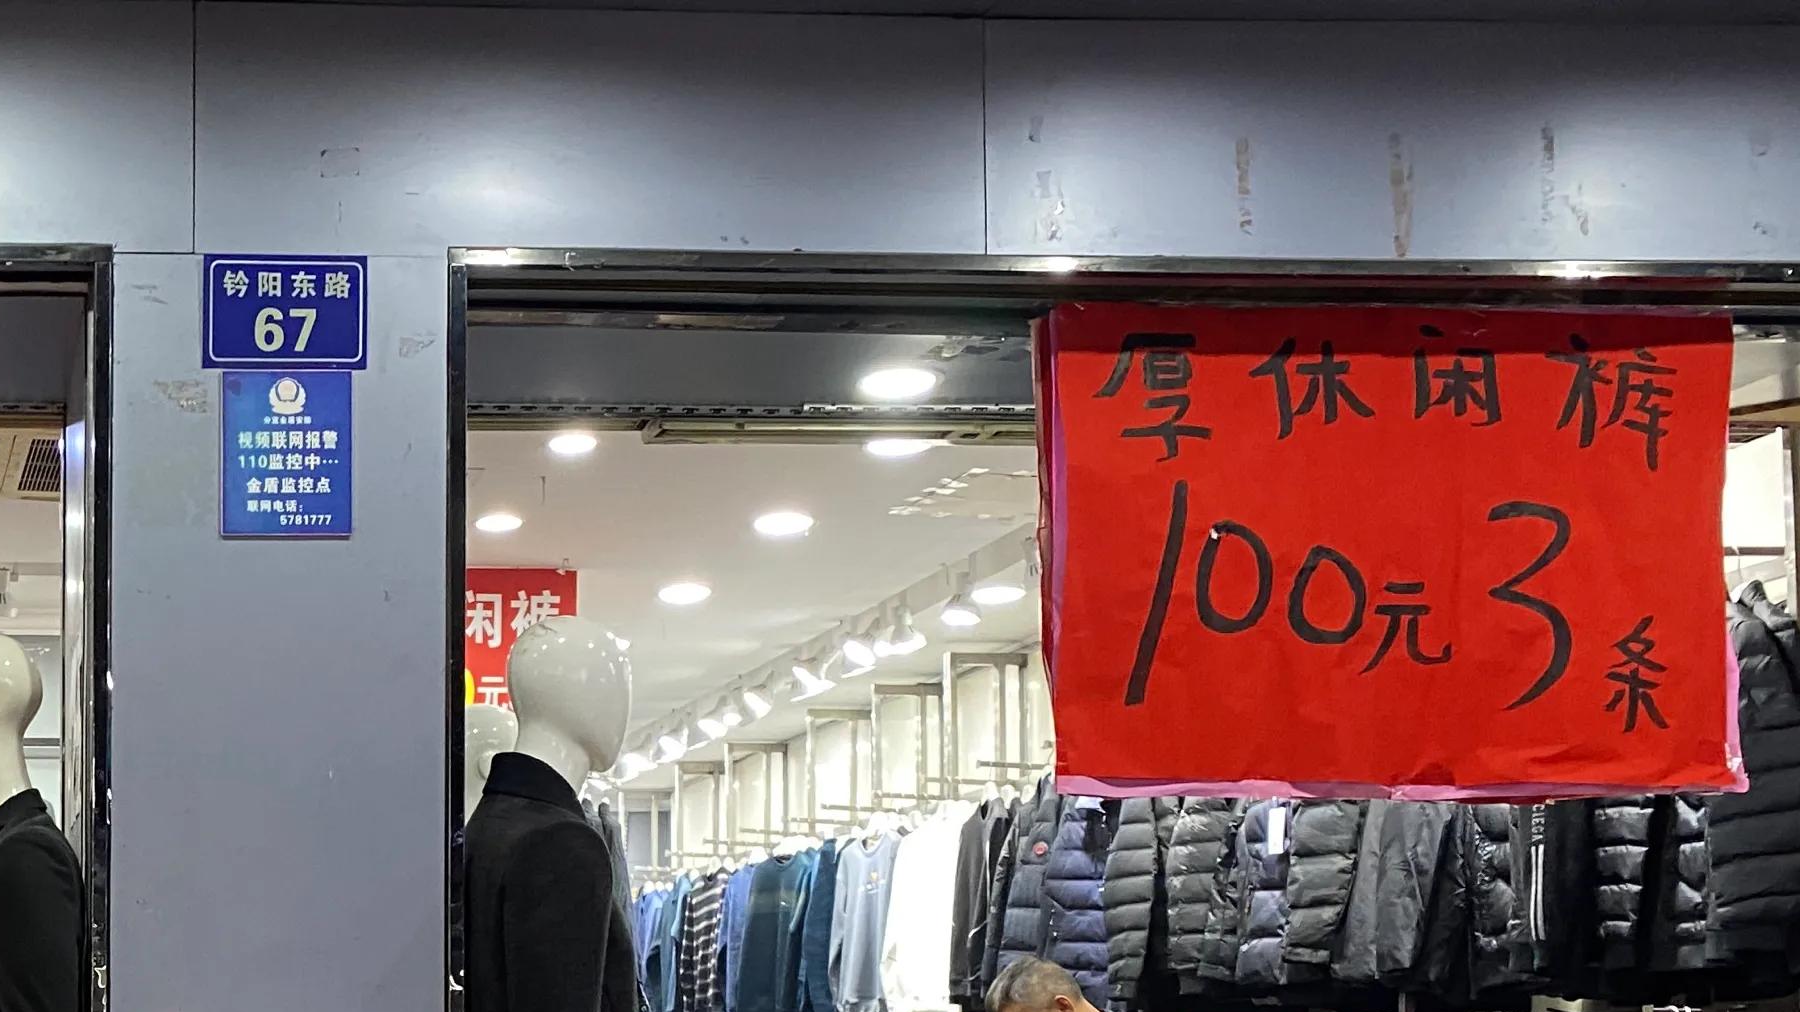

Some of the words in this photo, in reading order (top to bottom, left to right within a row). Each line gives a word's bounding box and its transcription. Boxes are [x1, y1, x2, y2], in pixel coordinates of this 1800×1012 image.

[223, 270, 351, 299] 钤阳东路
[255, 307, 316, 352] 67
[1092, 325, 1678, 471] 厚休闲裤
[238, 431, 337, 449] 视频联网报警
[247, 477, 331, 493] 金盾监控点
[280, 514, 332, 525] 5781777
